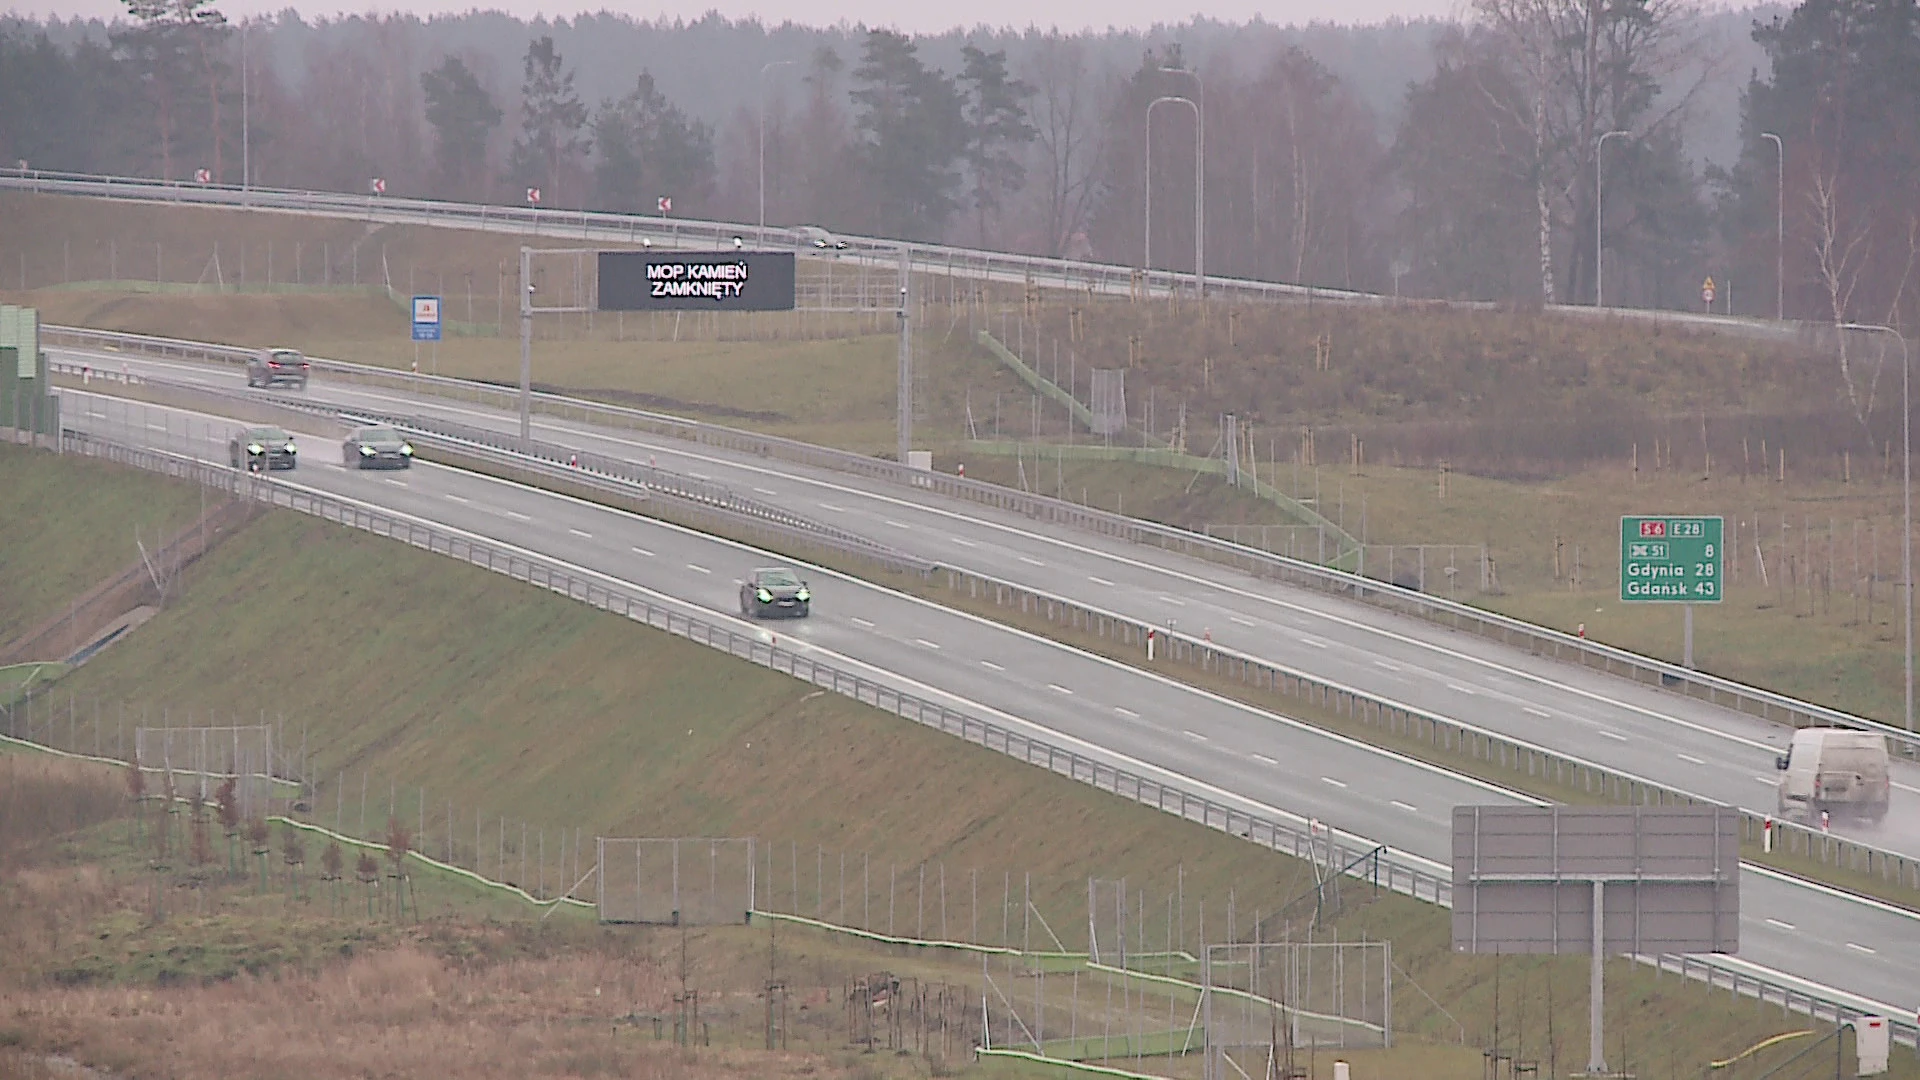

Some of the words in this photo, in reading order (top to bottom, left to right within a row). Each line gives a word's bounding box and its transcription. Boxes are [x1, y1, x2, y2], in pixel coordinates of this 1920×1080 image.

[647, 264, 684, 279] MOP
[687, 260, 747, 279] KAMIEŃ
[651, 281, 744, 300] ZAMKNIĘTY
[1705, 543, 1714, 558] 8
[1628, 562, 1684, 580] Gdynia
[1695, 563, 1715, 577] 28
[1627, 581, 1688, 595] Gdańsk
[1694, 581, 1715, 595] 43
